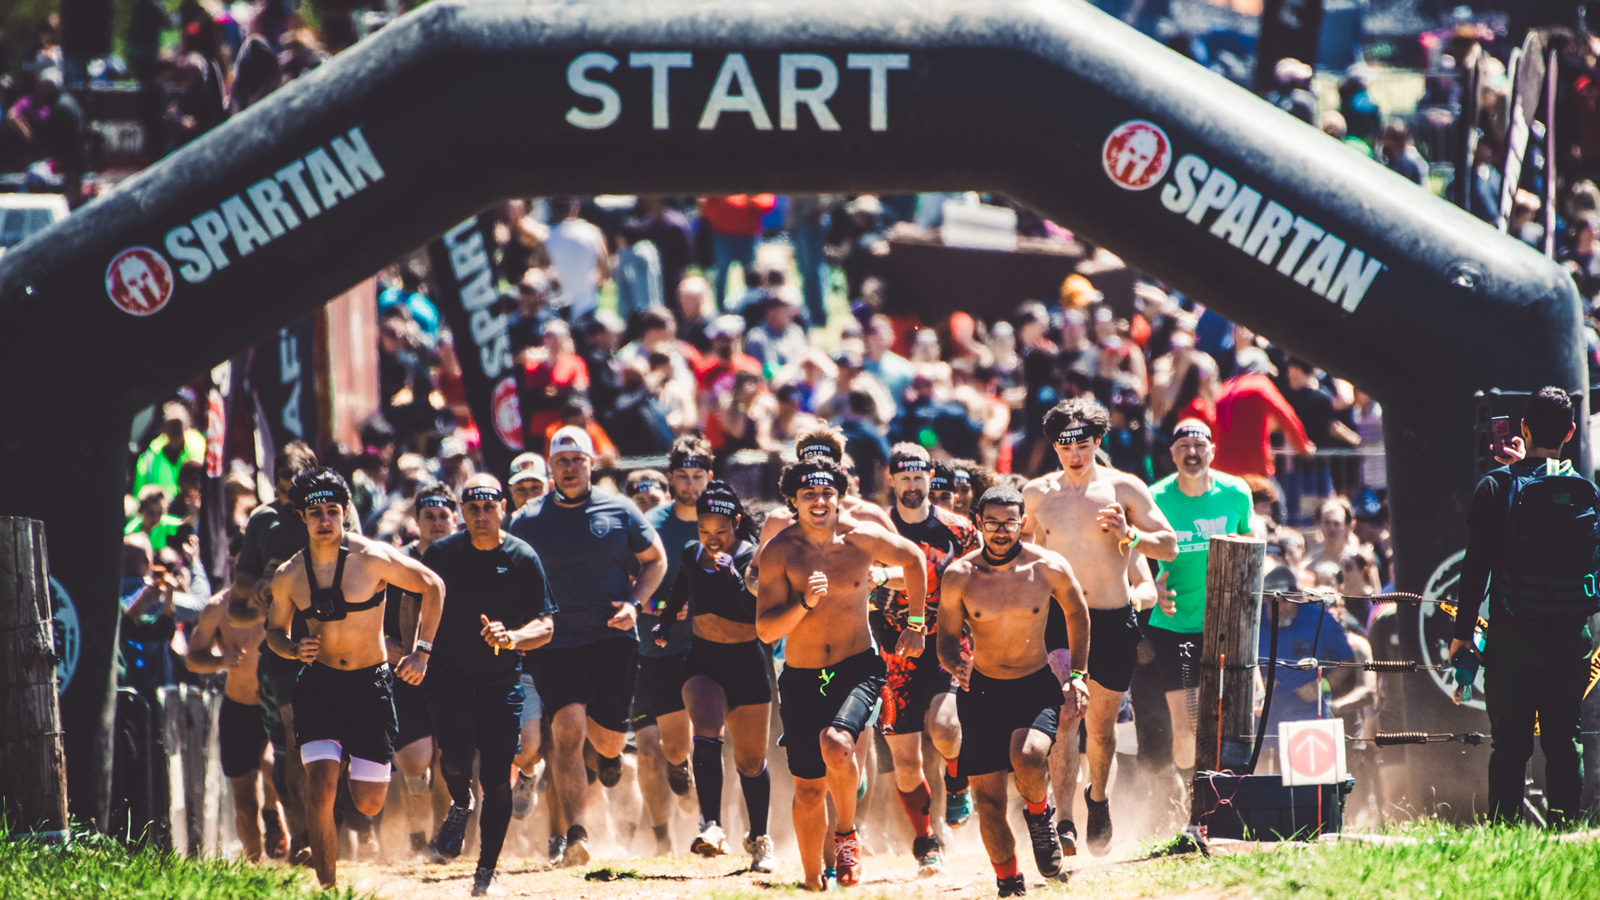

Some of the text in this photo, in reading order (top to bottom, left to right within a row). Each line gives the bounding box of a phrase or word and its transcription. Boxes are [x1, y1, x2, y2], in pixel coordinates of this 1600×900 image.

[565, 53, 910, 131] START
[165, 126, 384, 284] SPARTAN
[1161, 153, 1384, 313] SPARTAN
[804, 444, 831, 453] SPARTAN
[308, 490, 334, 500] SPARTAN
[807, 471, 834, 481] SPARTAN
